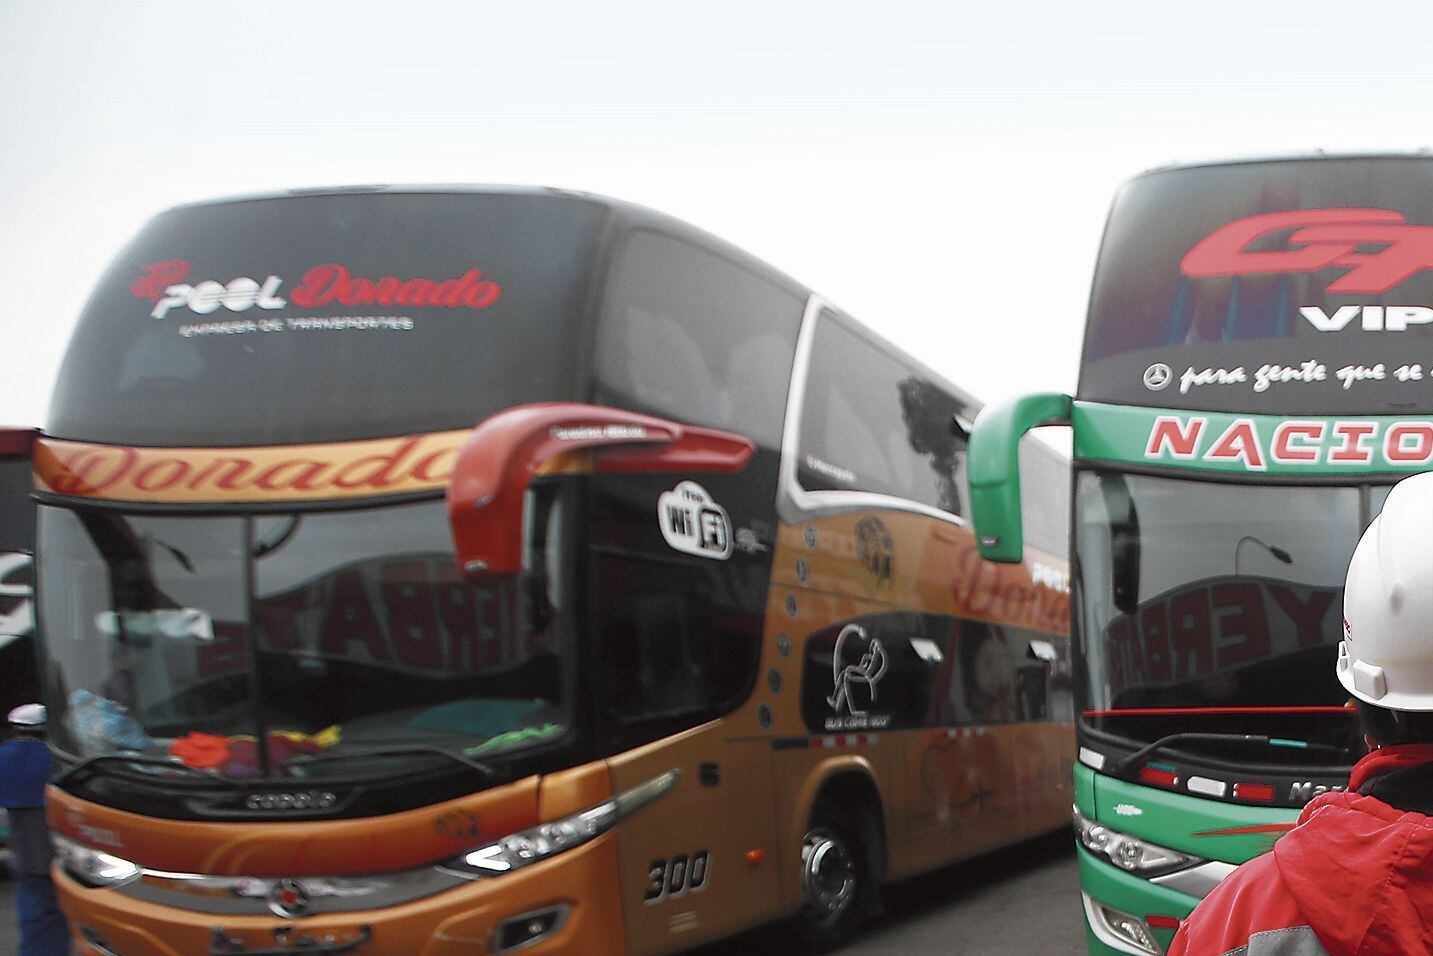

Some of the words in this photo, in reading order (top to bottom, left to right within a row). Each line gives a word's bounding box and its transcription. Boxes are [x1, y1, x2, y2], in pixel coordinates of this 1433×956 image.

[1179, 365, 1247, 394] para
[1253, 359, 1327, 393] gente
[1335, 363, 1386, 390] que
[1393, 363, 1423, 382] se
[643, 848, 713, 906] 300
